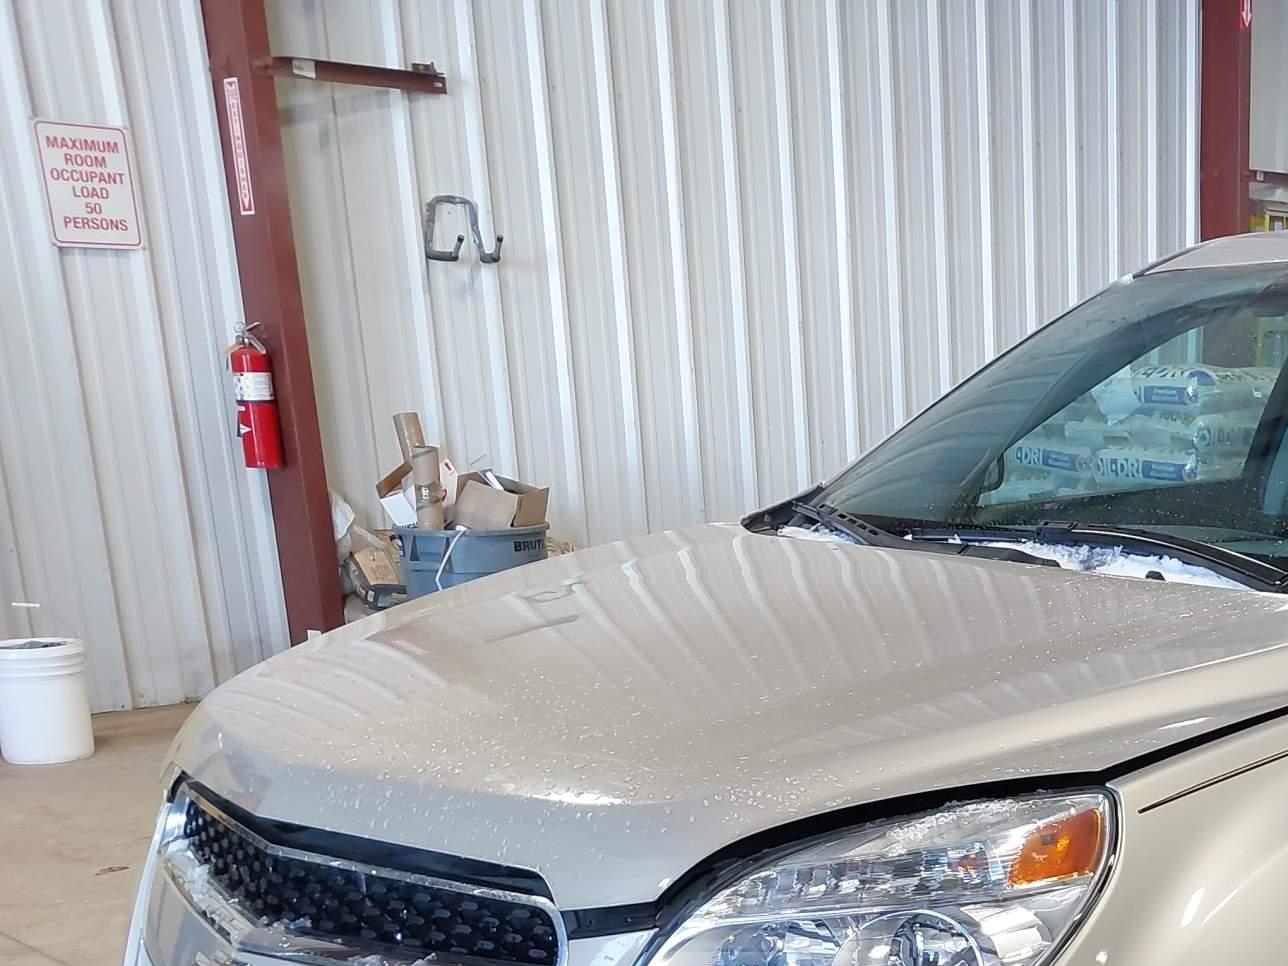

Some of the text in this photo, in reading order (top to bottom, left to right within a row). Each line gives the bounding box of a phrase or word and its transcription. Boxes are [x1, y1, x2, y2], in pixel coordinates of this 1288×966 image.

[45, 135, 120, 154] MAXIMUM
[63, 153, 108, 169] ROOM
[50, 167, 125, 185] OCCUPANT
[72, 185, 110, 200] LOAD
[84, 201, 103, 215] 50
[63, 216, 129, 232] PERSONS
